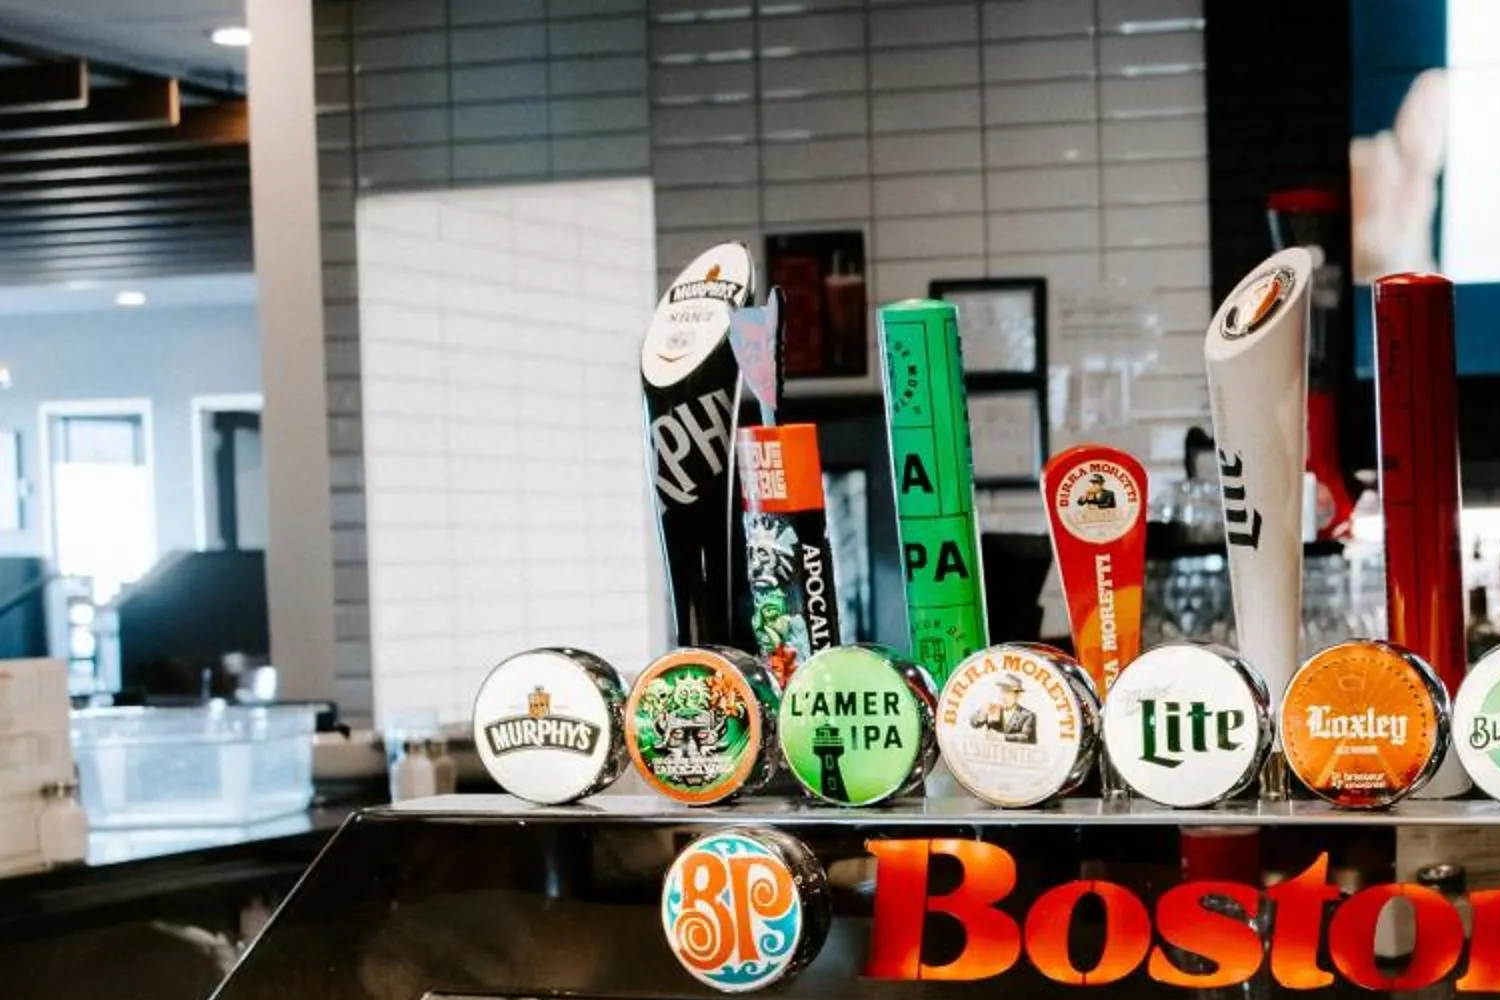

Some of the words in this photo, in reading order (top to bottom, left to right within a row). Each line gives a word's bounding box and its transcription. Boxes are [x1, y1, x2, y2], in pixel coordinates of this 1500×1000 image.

[801, 543, 831, 652] APOCAL
[790, 691, 901, 717] L'AMER
[943, 657, 998, 725] BIRRA
[1002, 655, 1077, 740] MORETTI
[1306, 704, 1409, 745] Loxley
[851, 724, 904, 749] IPA
[1137, 699, 1246, 769] Lite
